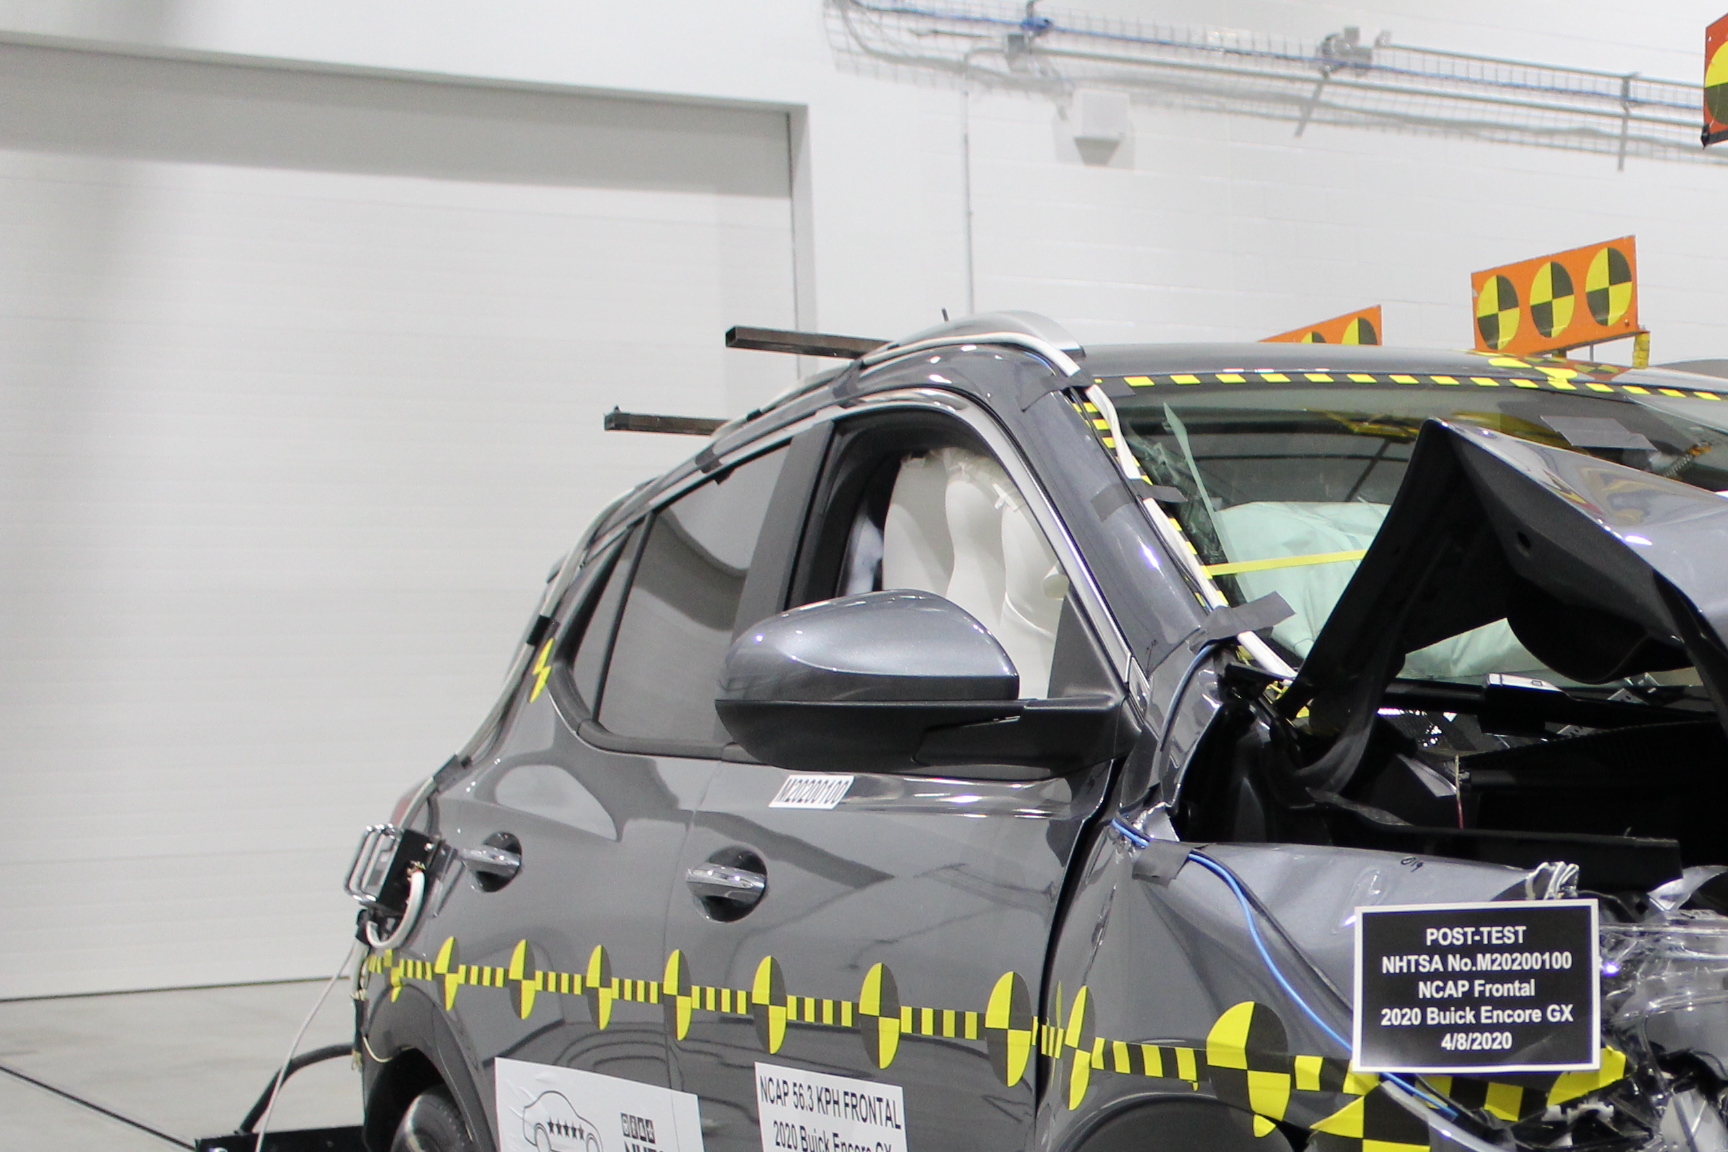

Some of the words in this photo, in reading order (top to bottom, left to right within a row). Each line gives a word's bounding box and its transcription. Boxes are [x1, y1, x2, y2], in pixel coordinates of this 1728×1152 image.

[774, 778, 849, 805] M20200100
[1426, 926, 1526, 946] POST-TEST
[1382, 955, 1443, 973] NHTSA
[1448, 952, 1572, 972] No.M20200100
[1418, 980, 1469, 998] NCAP
[1474, 979, 1535, 997] Frontal
[1381, 1008, 1421, 1026] 2020
[1426, 1006, 1475, 1025] Buick
[1480, 1006, 1542, 1024] Encore
[1546, 1004, 1573, 1022] GX
[1441, 1032, 1512, 1050] 4/8/2020
[760, 1075, 789, 1108] NCAP
[793, 1082, 814, 1112] 56.3
[816, 1086, 841, 1117] KPH
[844, 1090, 902, 1130] FRONTAL
[773, 1120, 798, 1150] 2020
